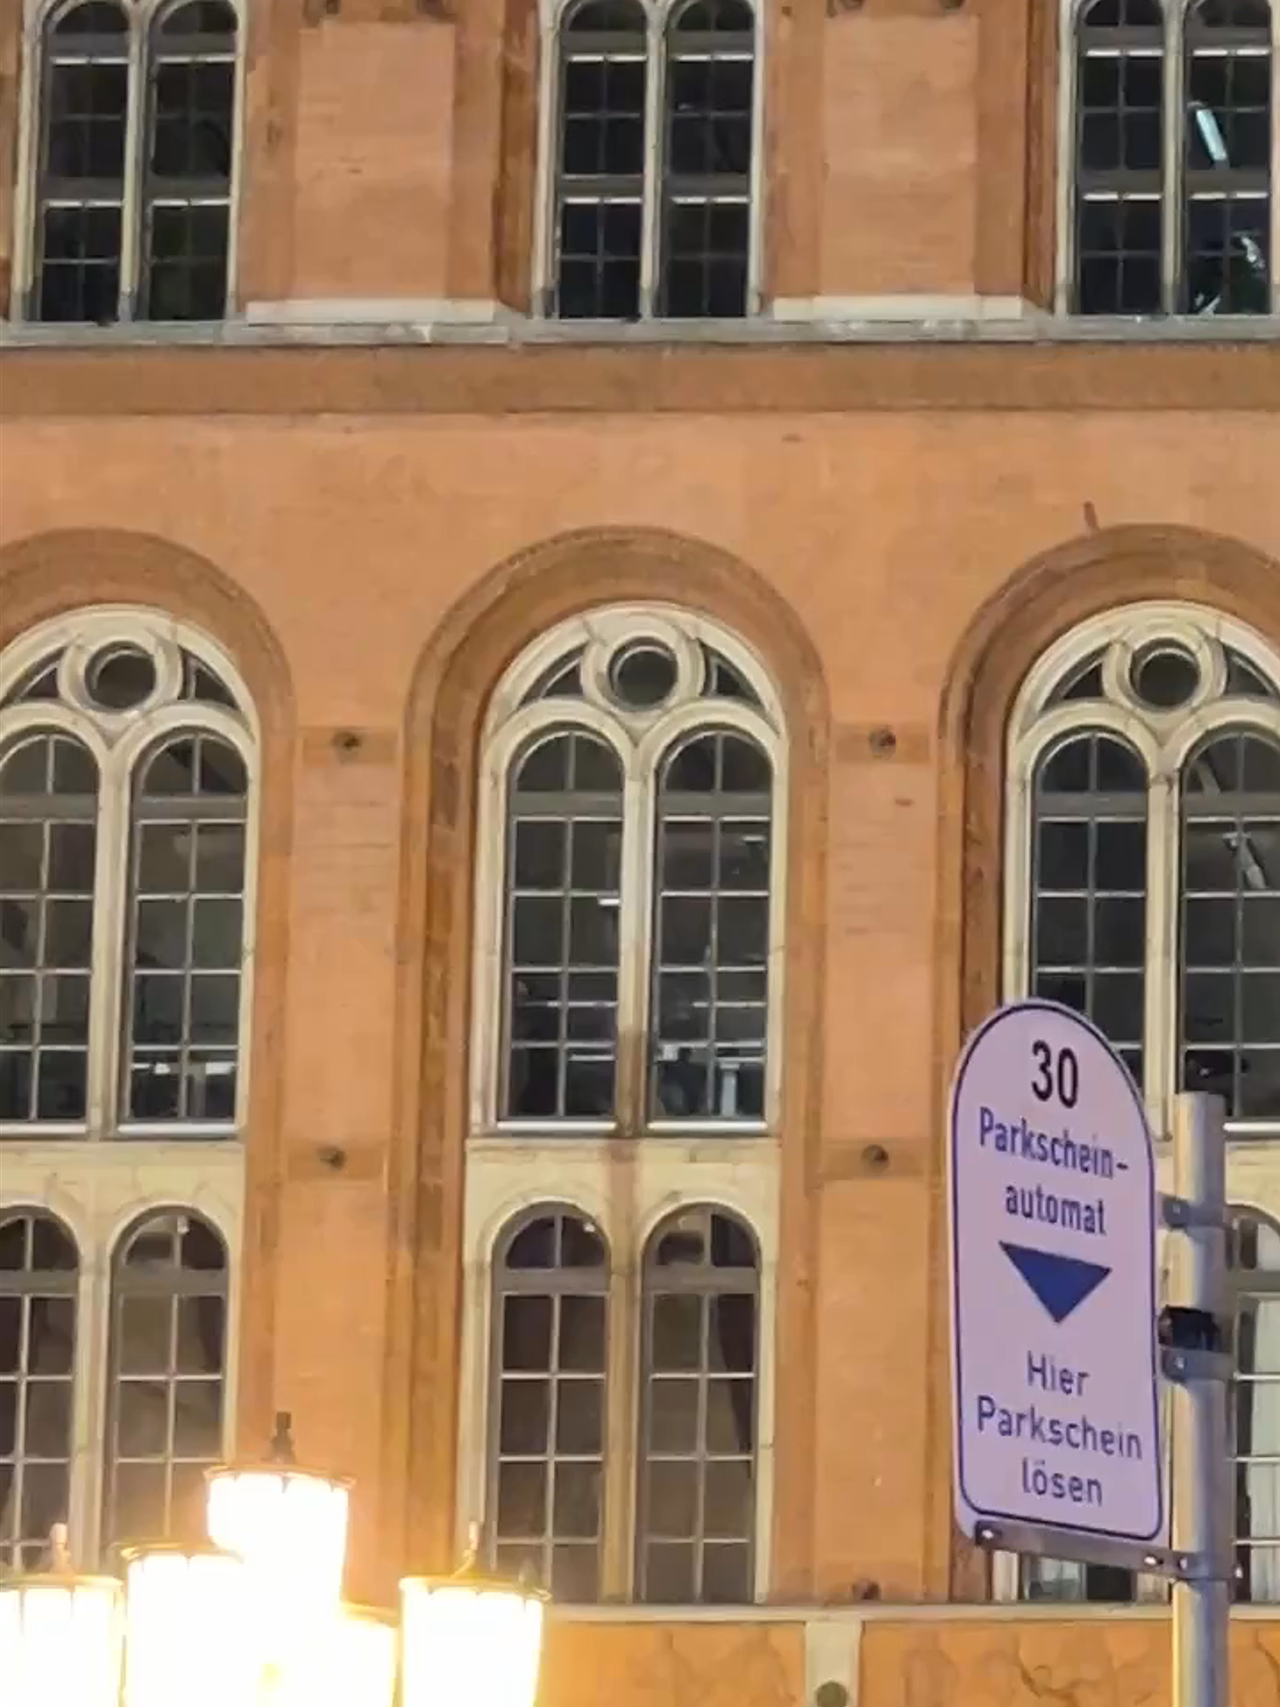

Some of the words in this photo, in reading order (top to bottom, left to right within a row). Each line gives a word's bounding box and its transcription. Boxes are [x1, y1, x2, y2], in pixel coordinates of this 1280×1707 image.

[1032, 1039, 1078, 1109] 30
[980, 1106, 1129, 1180] Parkschein-
[1006, 1183, 1107, 1236] automat
[1027, 1350, 1090, 1397] Hier
[977, 1394, 1142, 1460] Parkschein
[1022, 1456, 1103, 1508] lösen
